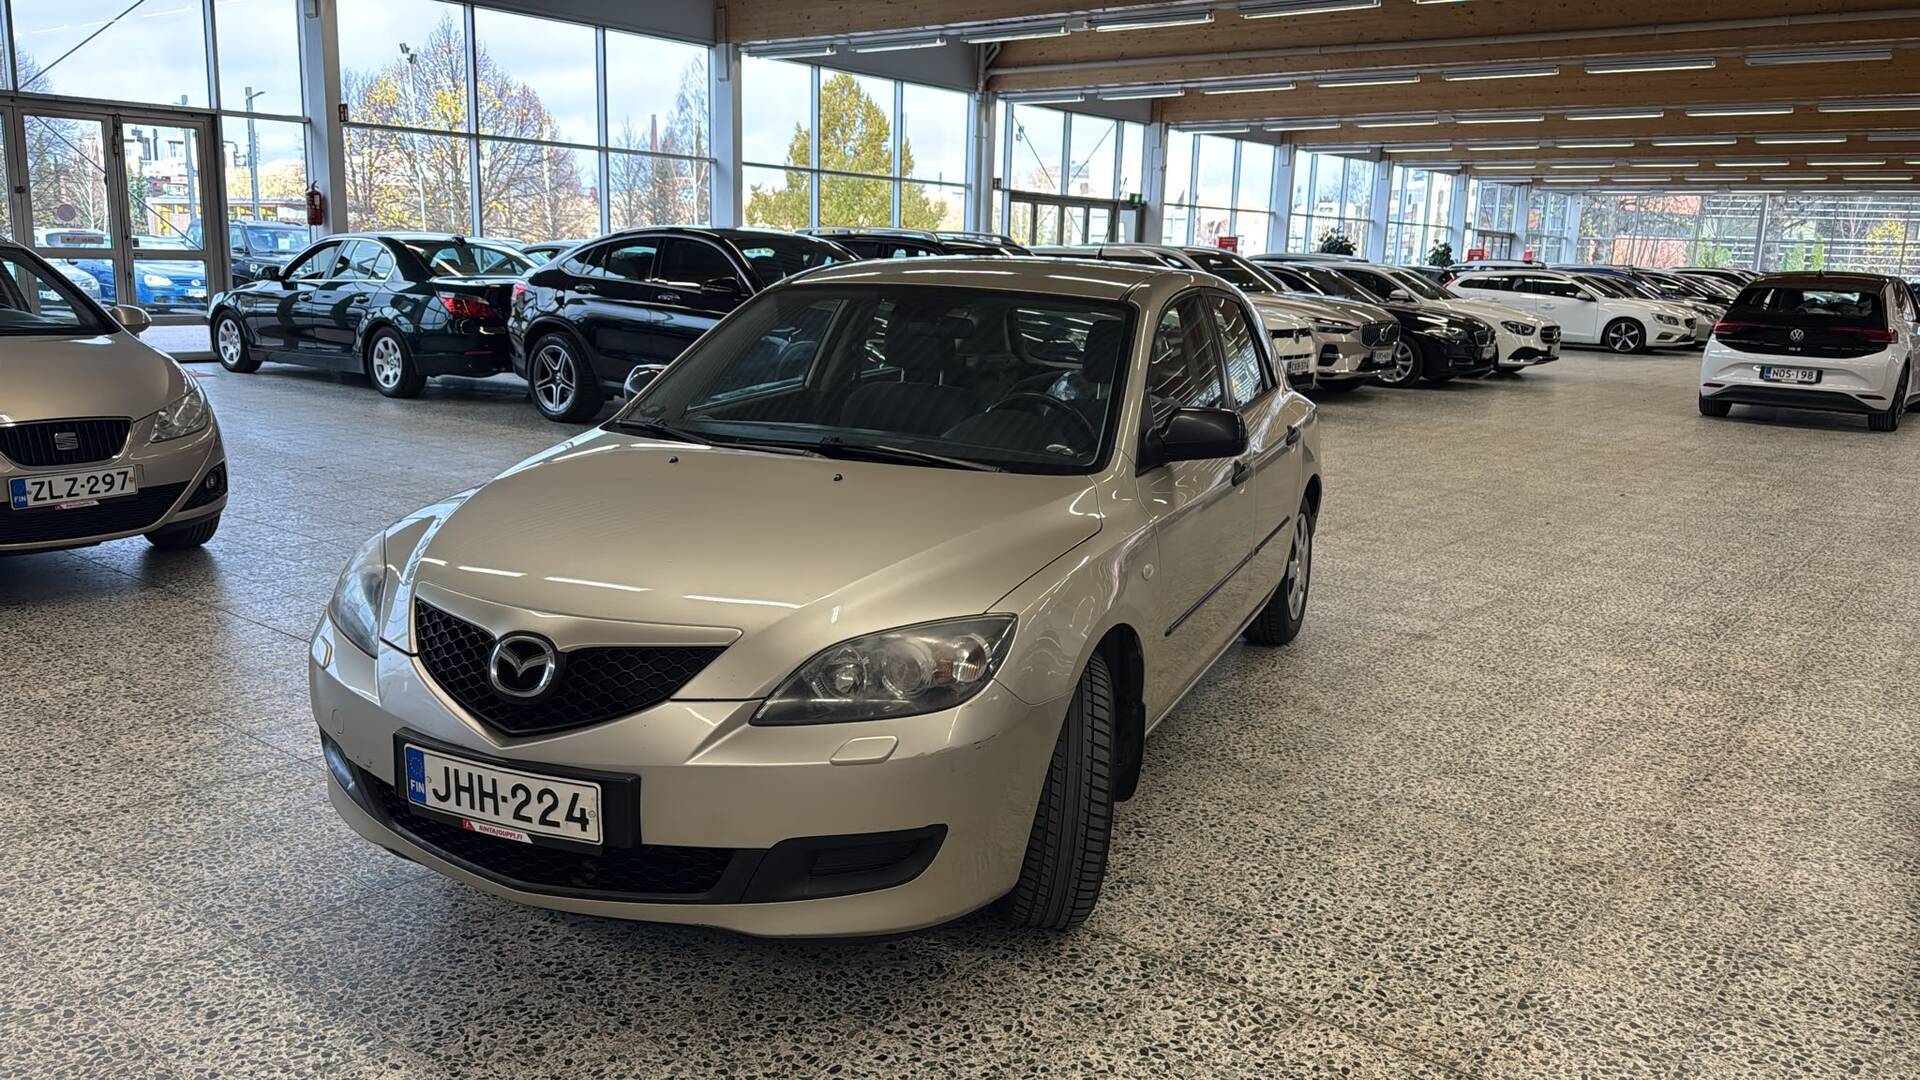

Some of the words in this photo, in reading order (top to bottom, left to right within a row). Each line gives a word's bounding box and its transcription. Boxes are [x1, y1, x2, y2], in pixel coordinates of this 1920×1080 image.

[1772, 368, 1814, 380] NOS-198
[31, 471, 130, 502] ZLZ-297
[14, 495, 26, 503] FIN
[410, 779, 425, 795] FIN
[432, 766, 590, 832] JHH-224
